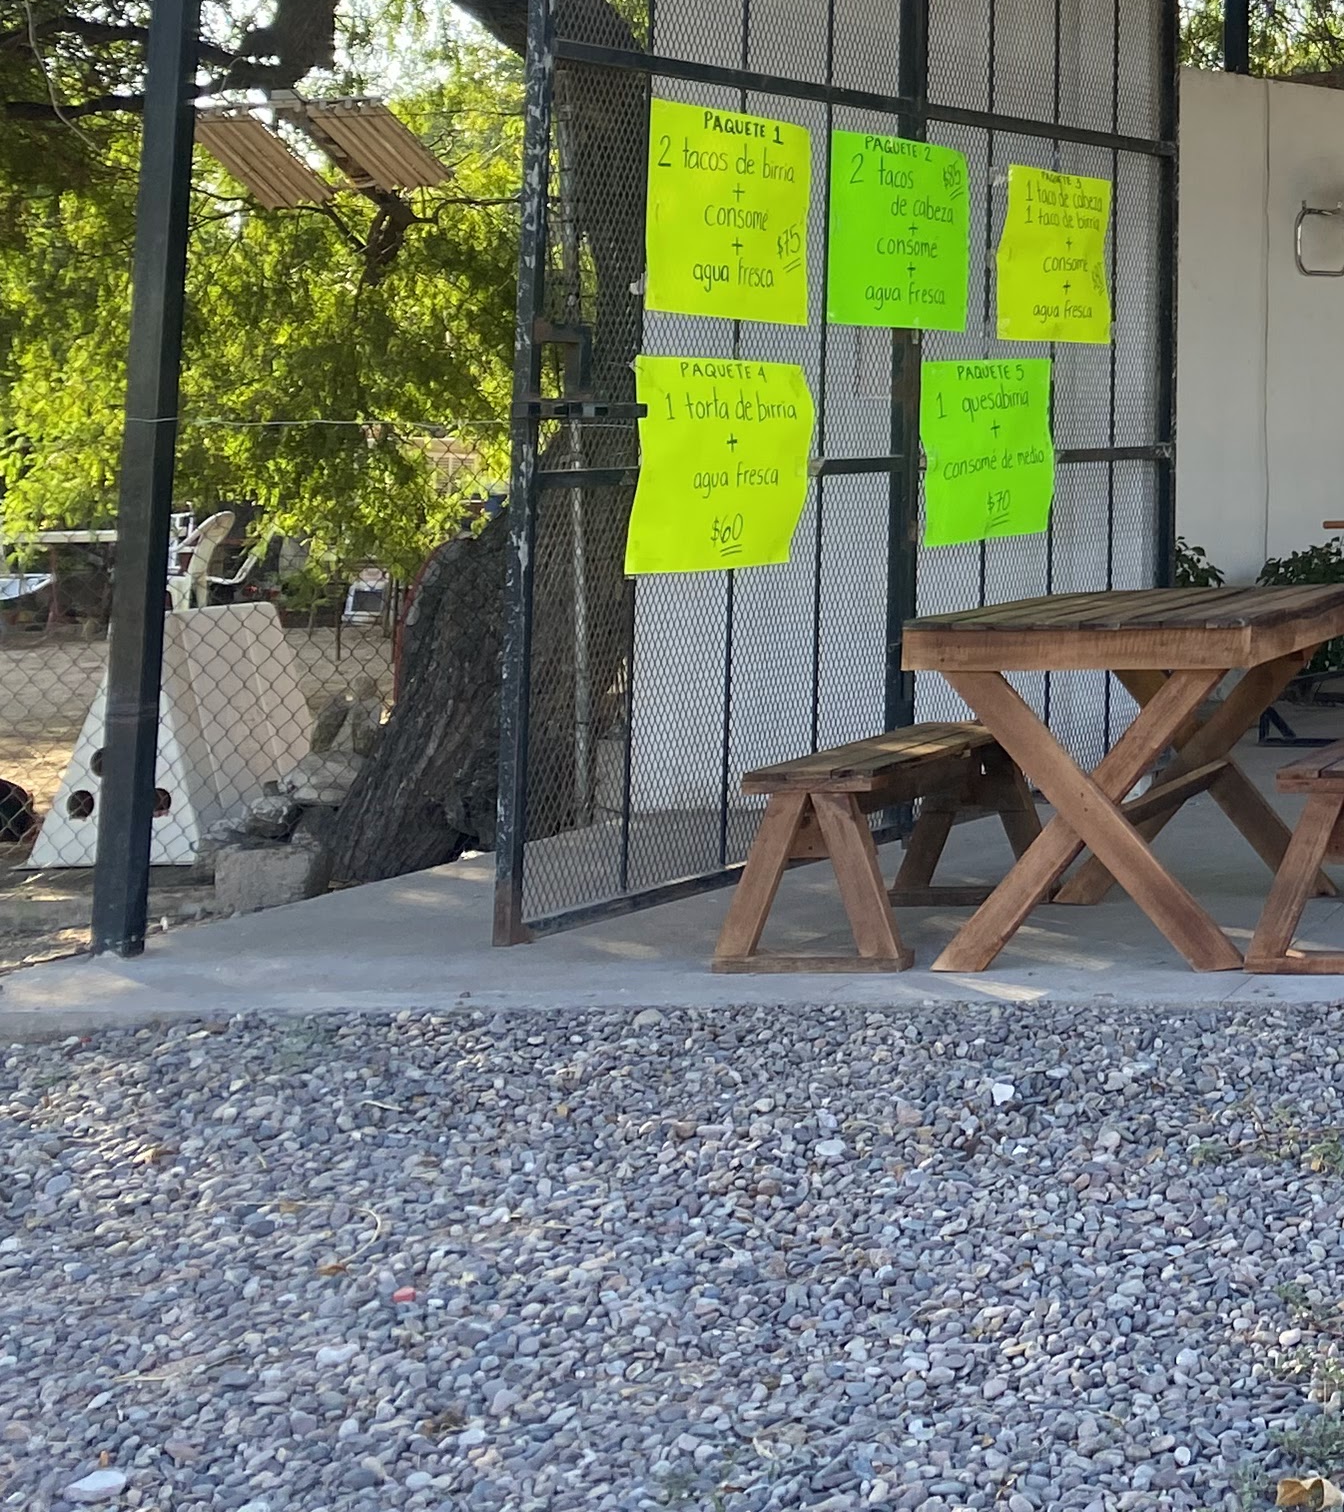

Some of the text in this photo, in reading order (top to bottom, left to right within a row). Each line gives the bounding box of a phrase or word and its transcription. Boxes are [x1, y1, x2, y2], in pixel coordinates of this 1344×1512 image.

[704, 110, 784, 145] PAQUETE 1
[657, 135, 796, 184] 2 tacos de birria
[864, 135, 933, 162] PAQUETE 2
[849, 153, 914, 189] 2 tacos
[1075, 178, 1082, 190] 3
[890, 194, 954, 225] de cabeza
[1025, 180, 1103, 213] 1 taco de cabeza
[1024, 205, 1033, 224] 1
[1038, 207, 1060, 228] taco
[1062, 209, 1075, 229] de
[777, 223, 802, 260] $75
[692, 257, 775, 293] agua fresca
[864, 281, 945, 311] agua fresca
[1032, 299, 1093, 324] agua fresca
[680, 361, 767, 383] PAQUETE 4
[957, 364, 1025, 382] PAQUETE 5
[665, 386, 798, 423] 1 torta de birria
[936, 392, 948, 420] 1
[943, 445, 1045, 481] consomé de medio
[693, 460, 779, 500] agua fresca
[986, 489, 1011, 515] $70
[710, 512, 744, 547] $60
